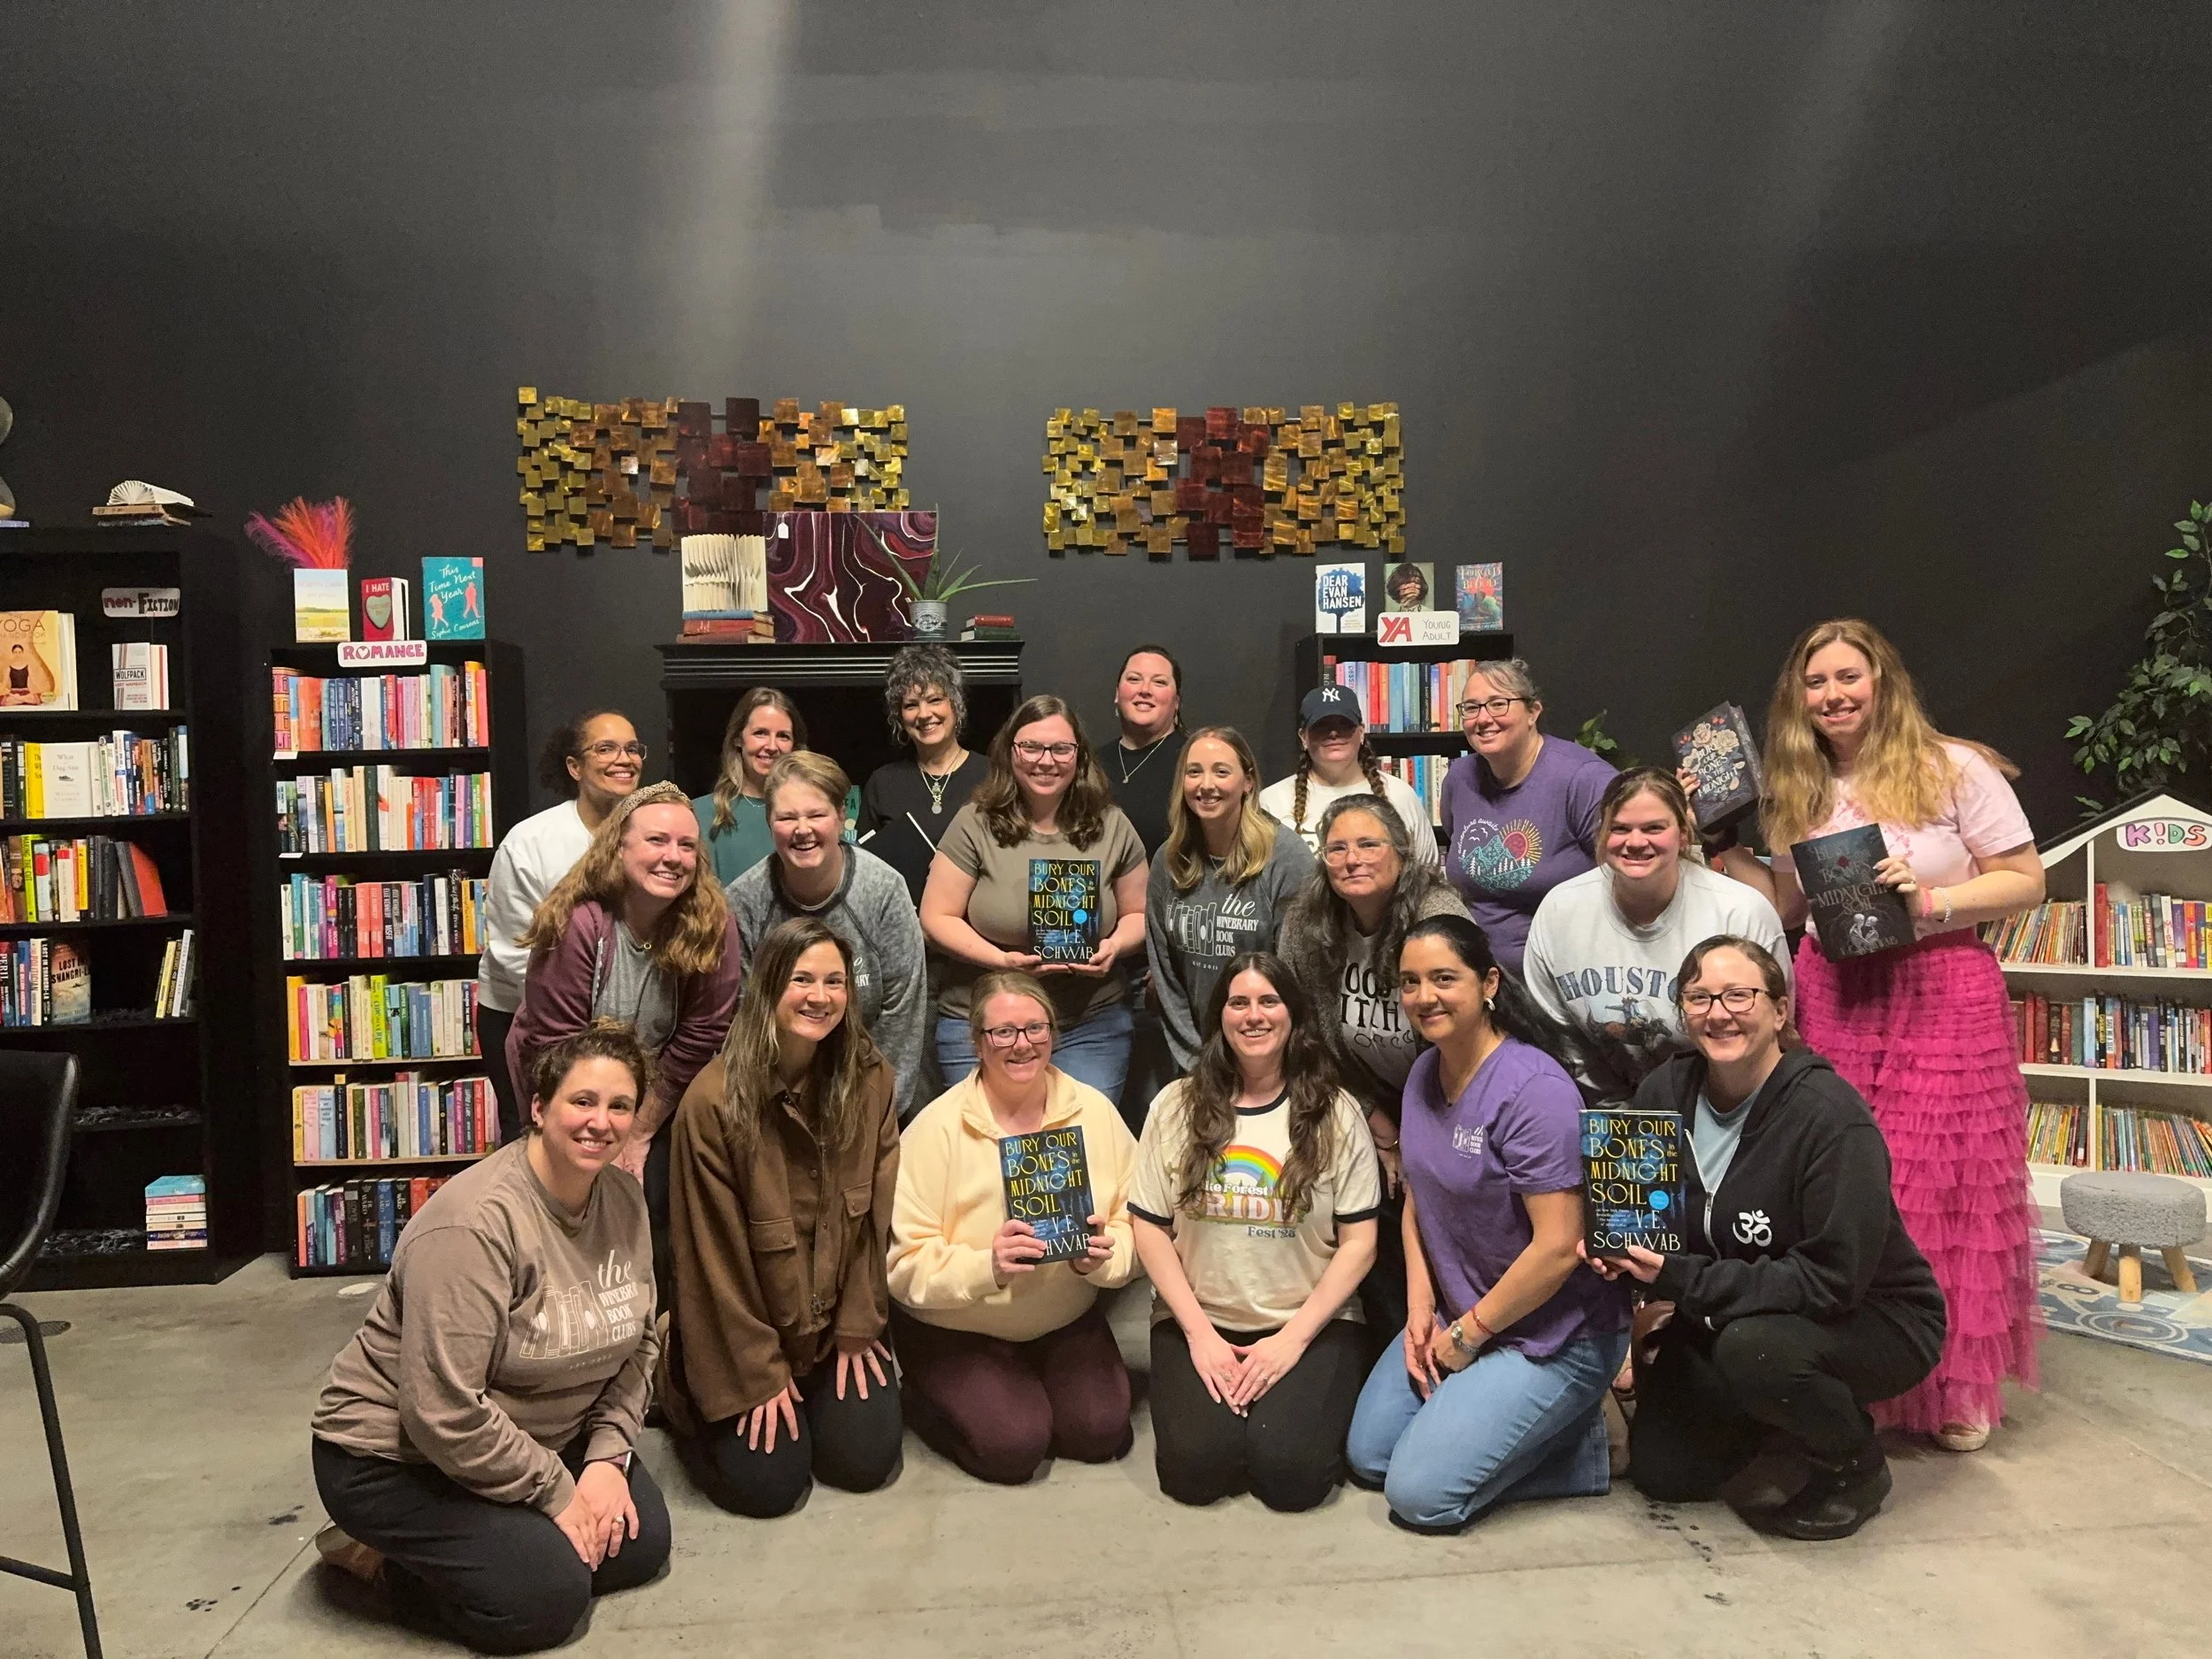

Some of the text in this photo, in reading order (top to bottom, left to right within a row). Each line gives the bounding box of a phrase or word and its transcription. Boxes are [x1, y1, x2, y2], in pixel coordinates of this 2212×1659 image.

[439, 564, 458, 579] This
[365, 582, 389, 593] I HATE
[428, 571, 476, 593] Time Next
[1323, 574, 1348, 588] DEAR
[442, 589, 464, 603] Year
[1323, 587, 1348, 598] EVAN
[1323, 596, 1362, 610] HANSEN
[0, 619, 45, 632] OGA
[1379, 617, 1413, 643] YA
[1423, 618, 1451, 630] YOUNG
[1422, 631, 1451, 641] ADULT
[342, 644, 425, 660] ROMANCE
[115, 669, 145, 680] WOLFPACK
[1322, 687, 1340, 703] NY
[1698, 767, 1739, 797] MIDNIGHT
[1034, 864, 1095, 876] BURY OUR
[1034, 878, 1087, 893] BONES
[1033, 895, 1095, 909] MIDNIGHT
[1222, 894, 1256, 917] the
[1033, 910, 1072, 926] SOIL
[1064, 929, 1085, 943] V.E.
[1216, 930, 1233, 943] BOOK
[1033, 946, 1094, 959] SCHWAB
[1215, 944, 1235, 956] CLUBS
[0, 953, 9, 980] PERIL
[58, 958, 76, 971] LOST
[1555, 966, 1678, 1004] HOUSTO
[1589, 1119, 1676, 1136] BURY OUR
[1005, 1132, 1078, 1156] BURY OUR
[1590, 1137, 1664, 1160] BONES
[1007, 1150, 1070, 1178] BONES
[1591, 1162, 1678, 1182] MIDNIGHT
[1010, 1169, 1082, 1197] MIDNIGHT
[1224, 1182, 1268, 1195] Forest
[1592, 1183, 1647, 1205] SOIL
[1013, 1194, 1061, 1218] SOIL
[1051, 1214, 1079, 1234] V.E.
[1635, 1210, 1666, 1229] V.E.
[1248, 1226, 1276, 1239] Fest
[1045, 1233, 1090, 1256] HWAB
[1594, 1232, 1681, 1251] SCHWAB
[597, 1249, 631, 1289] the
[605, 1303, 634, 1325] BOOK
[611, 1320, 637, 1342] CLUBS
